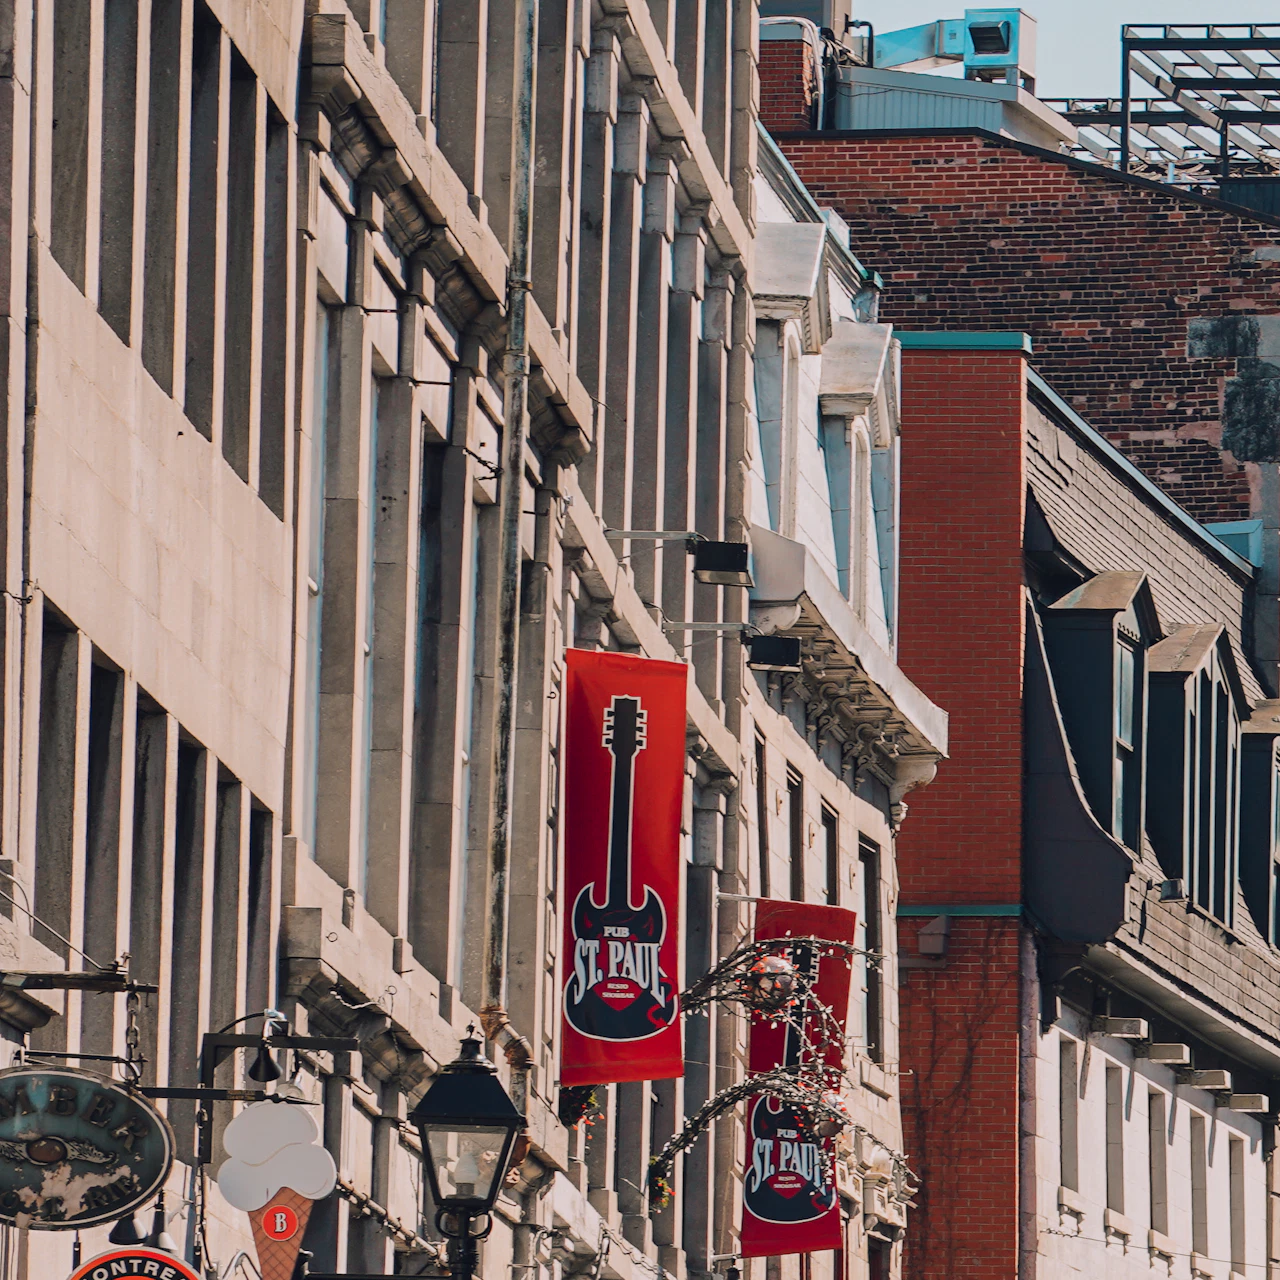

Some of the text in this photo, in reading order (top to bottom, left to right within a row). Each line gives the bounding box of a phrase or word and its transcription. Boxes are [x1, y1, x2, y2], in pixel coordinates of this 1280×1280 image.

[603, 926, 630, 938] PUB
[573, 937, 666, 1008] ST. PAUL
[776, 1128, 799, 1139] PUB
[752, 1137, 826, 1196] ST. PAUL
[274, 1212, 287, 1232] B
